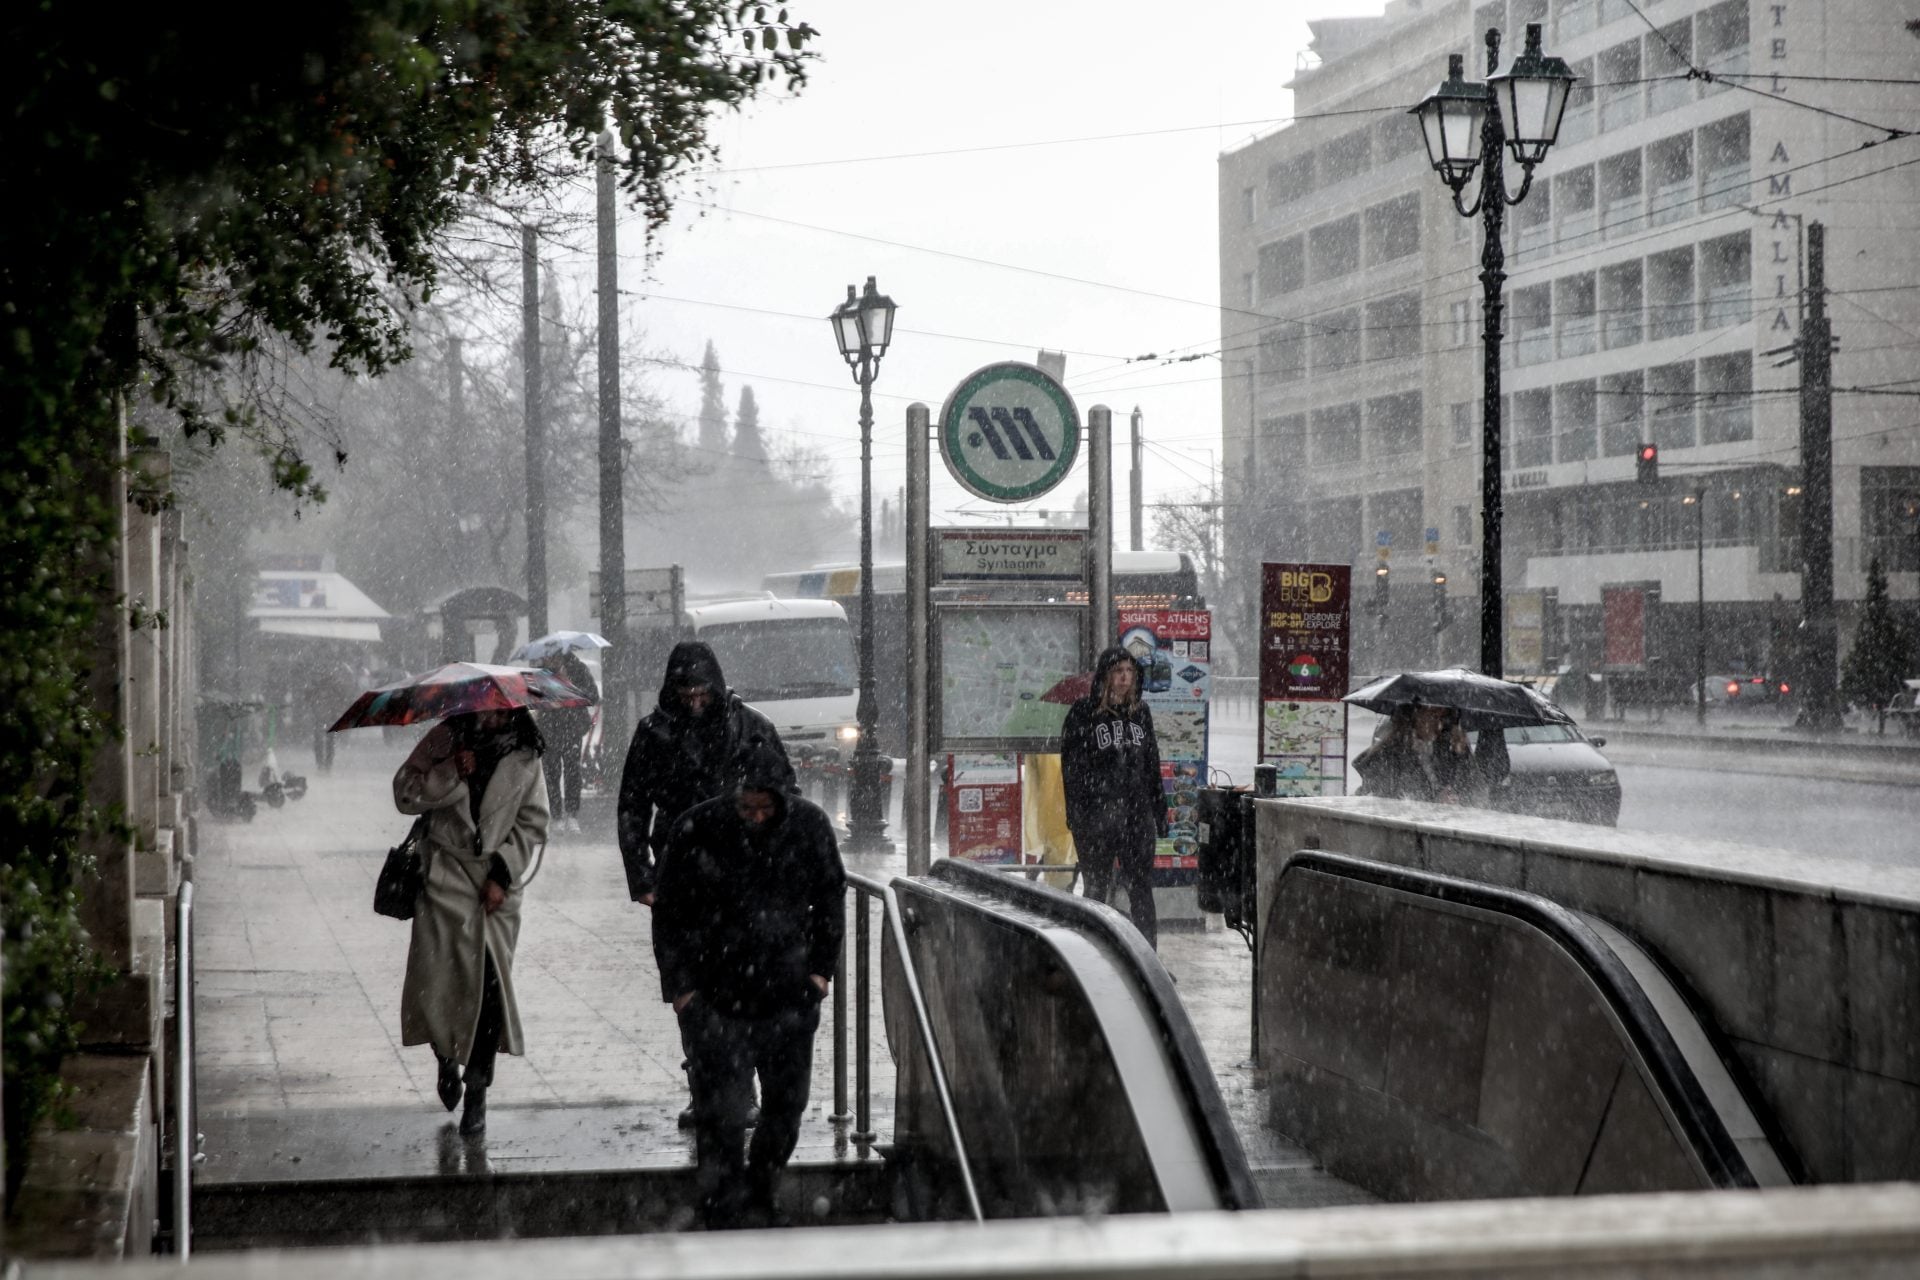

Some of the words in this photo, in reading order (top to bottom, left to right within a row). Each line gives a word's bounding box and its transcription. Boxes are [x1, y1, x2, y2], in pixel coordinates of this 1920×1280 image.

[1769, 141, 1791, 330] AMALIA
[966, 541, 1058, 560] Σύνταγμα
[977, 558, 1047, 571] Syntagma
[1281, 571, 1310, 588] BIG
[1281, 587, 1310, 602] BUS
[1121, 612, 1158, 624] SIGHTS
[1167, 613, 1209, 624] ATHENS
[1270, 612, 1302, 621] HOP-ON
[1303, 612, 1342, 621] DISCOVER
[1270, 619, 1306, 629] HOP-OFF
[1306, 620, 1342, 629] EXPLORE
[1300, 663, 1310, 677] 6
[1095, 720, 1145, 749] GAP
